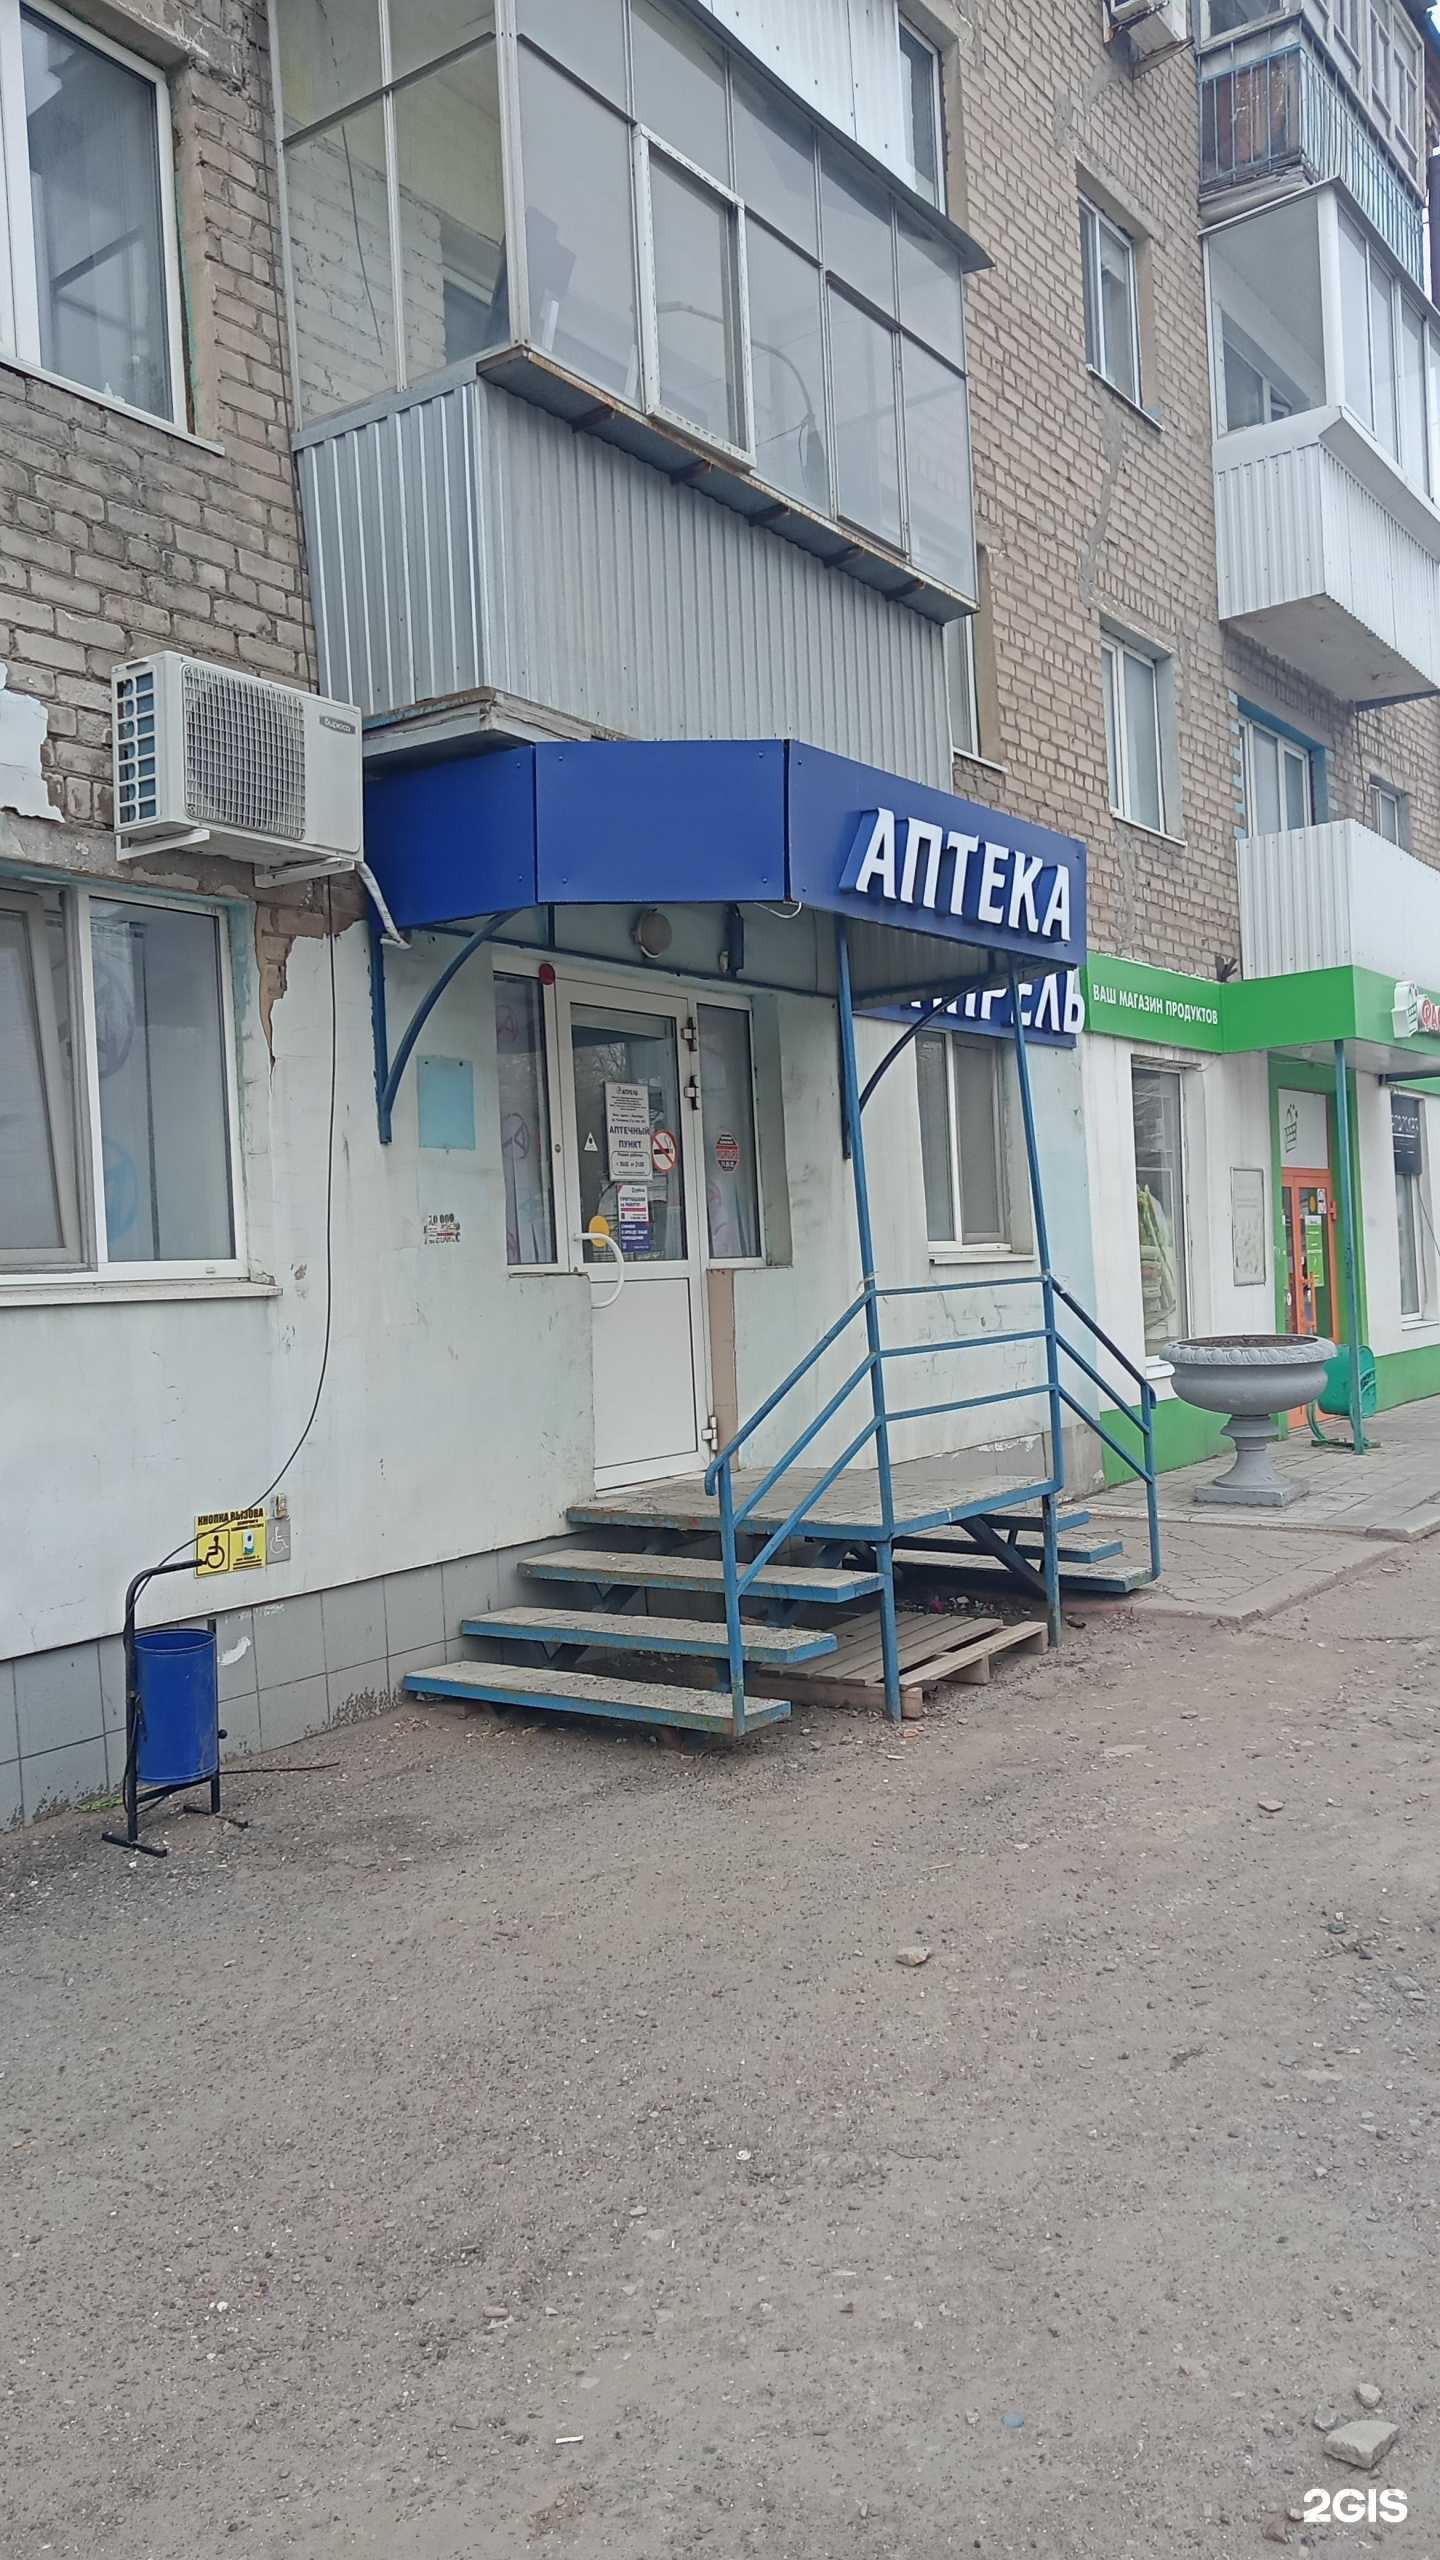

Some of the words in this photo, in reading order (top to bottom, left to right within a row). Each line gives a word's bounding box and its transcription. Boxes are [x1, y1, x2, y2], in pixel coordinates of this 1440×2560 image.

[855, 807, 1071, 942] АПТЕКА
[1092, 983, 1117, 1004] ВАШ
[1119, 990, 1163, 1016] МАГАЗИН
[1165, 999, 1218, 1025] ПРОДУКТОВ
[609, 1125, 650, 1136] АПТЕЧНЫЙ
[618, 1139, 642, 1149] ПУНКТ
[197, 1512, 228, 1526] КНОПКА
[230, 1507, 263, 1520] ВЫЗОВА
